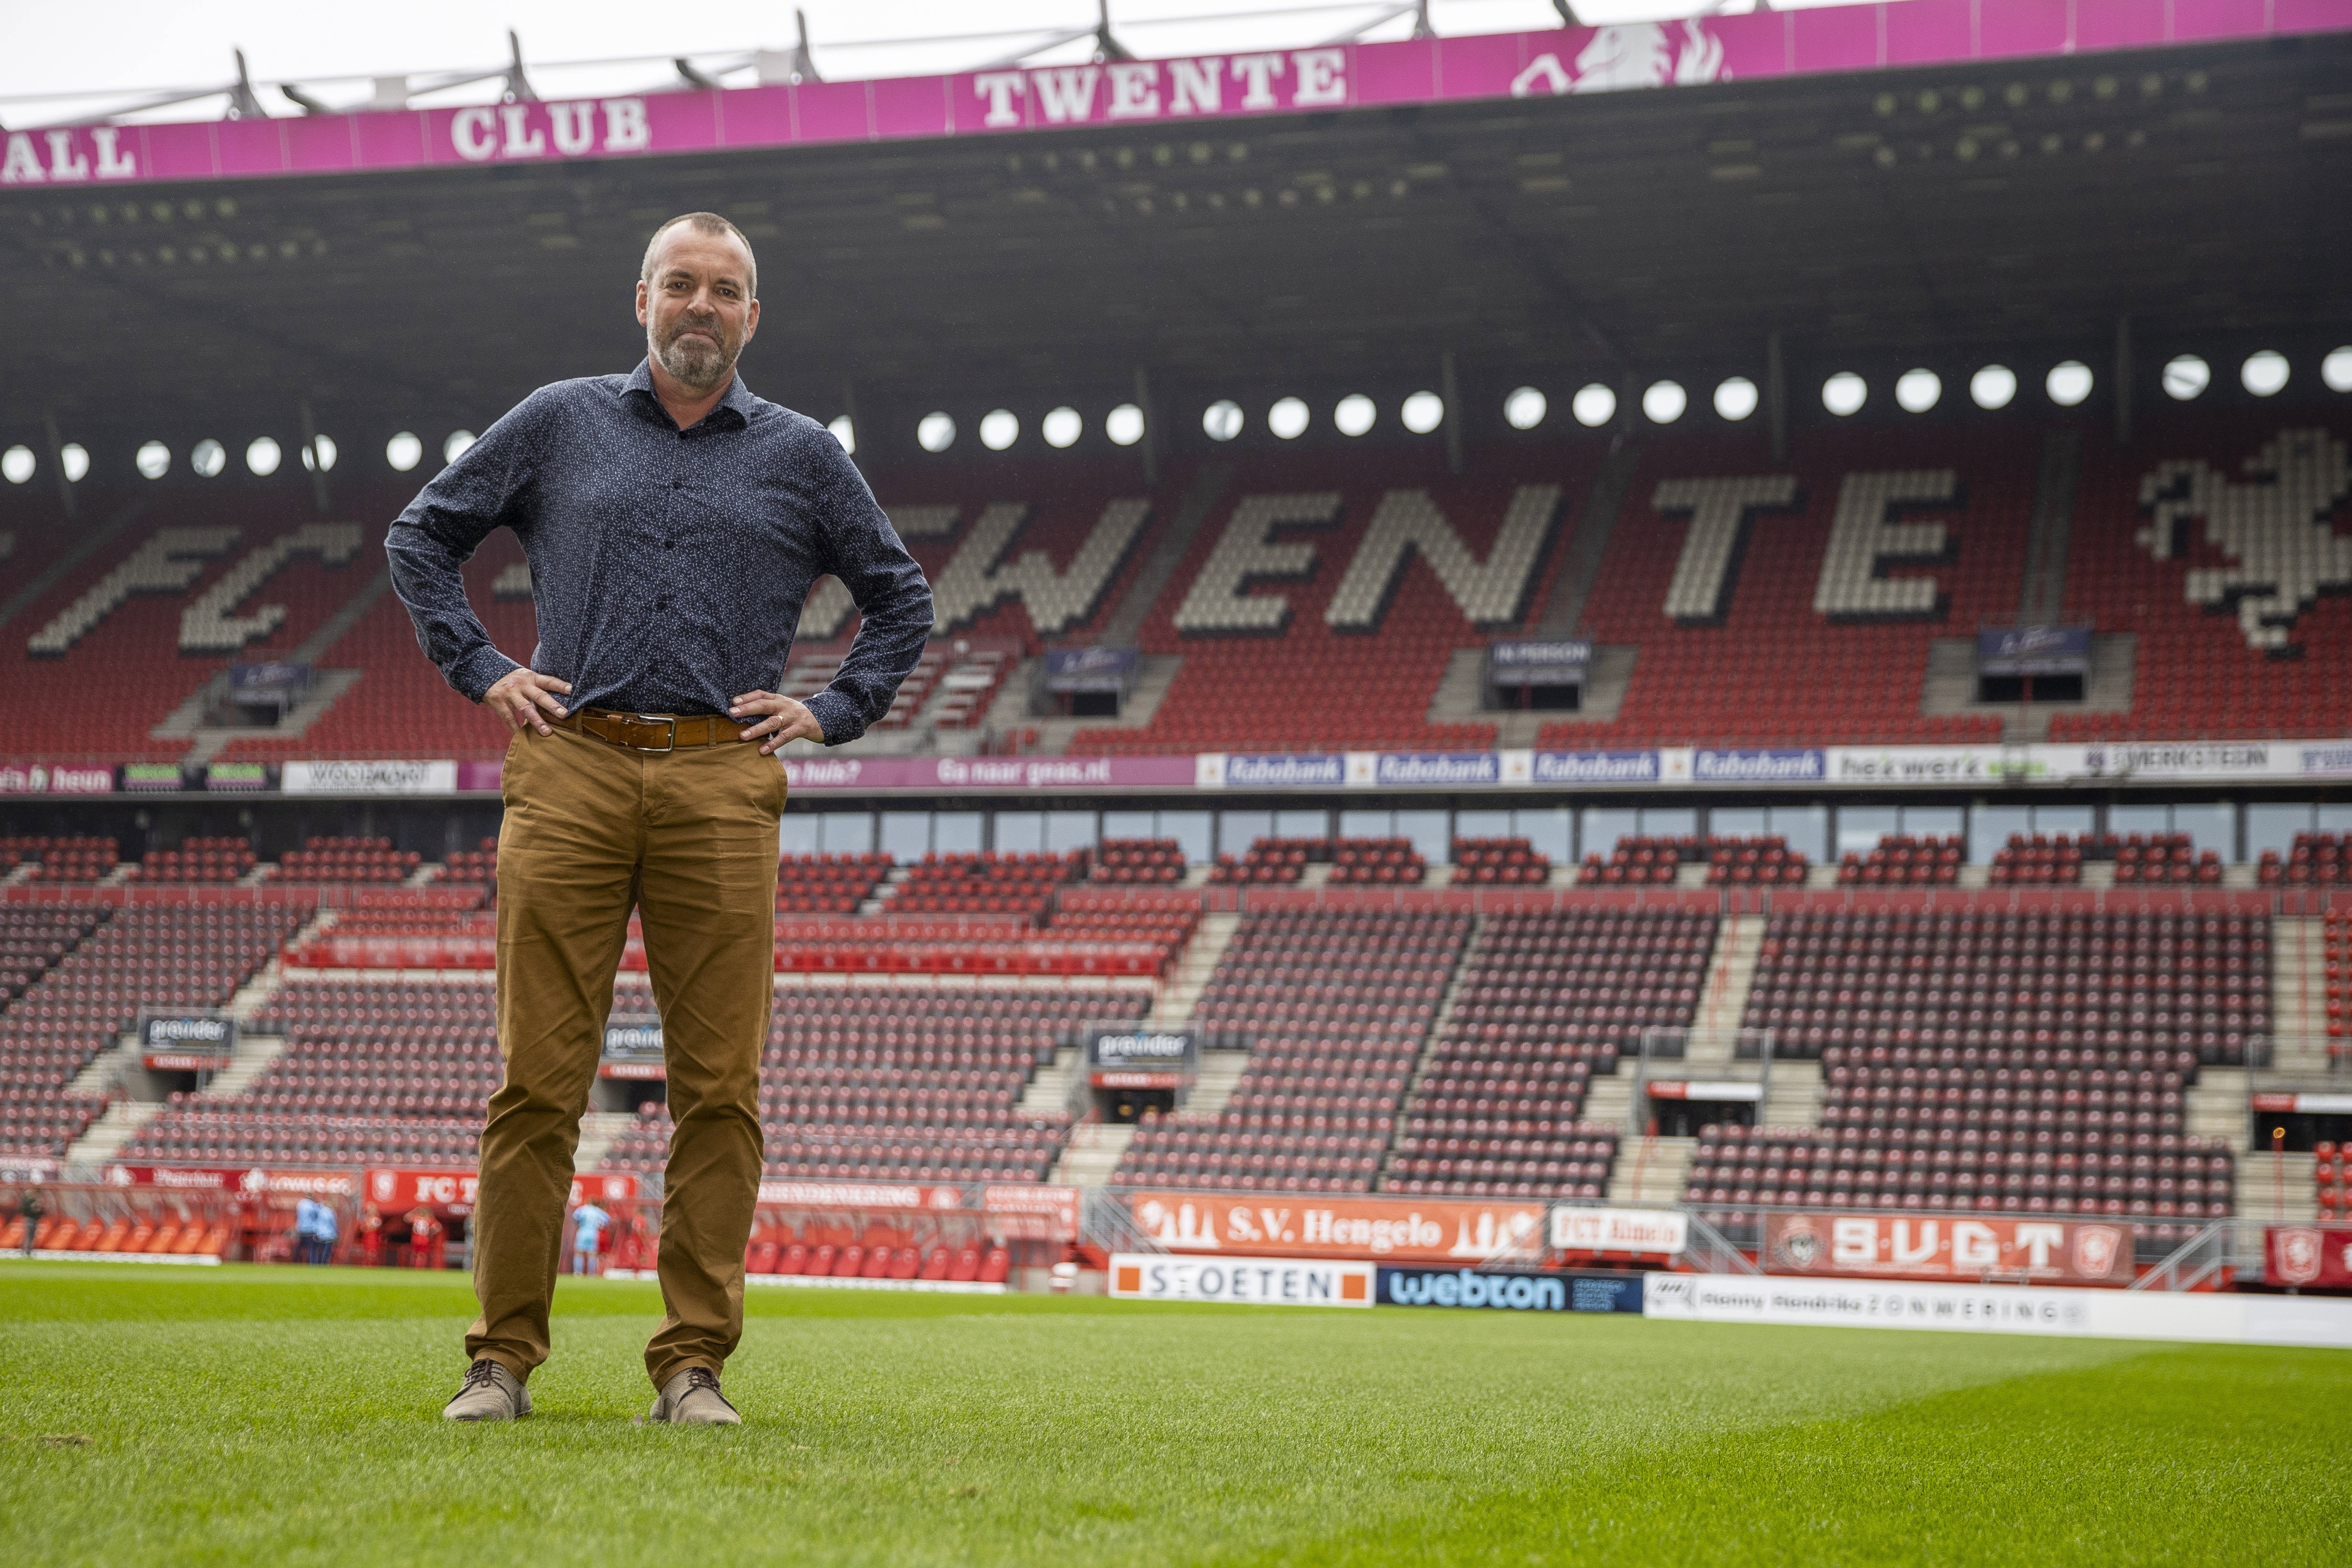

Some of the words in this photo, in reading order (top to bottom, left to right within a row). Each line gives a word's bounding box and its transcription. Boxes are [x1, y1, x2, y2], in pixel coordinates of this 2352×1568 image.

[975, 48, 1347, 128] TWENTE
[452, 98, 649, 161] CLUB
[29, 525, 362, 654] FC
[939, 760, 967, 781] Ga
[973, 764, 1022, 781] naar
[1229, 756, 1339, 780] Rabobank
[1380, 755, 1495, 779] Rabobank
[1537, 752, 1654, 778] Rabobank
[1696, 750, 1819, 776] Rabobank
[55, 768, 110, 790] heun
[416, 1176, 455, 1201] FC
[1228, 1206, 1295, 1242] S.V.
[1303, 1208, 1442, 1254] Hengelo
[1389, 1268, 1565, 1310] webton
